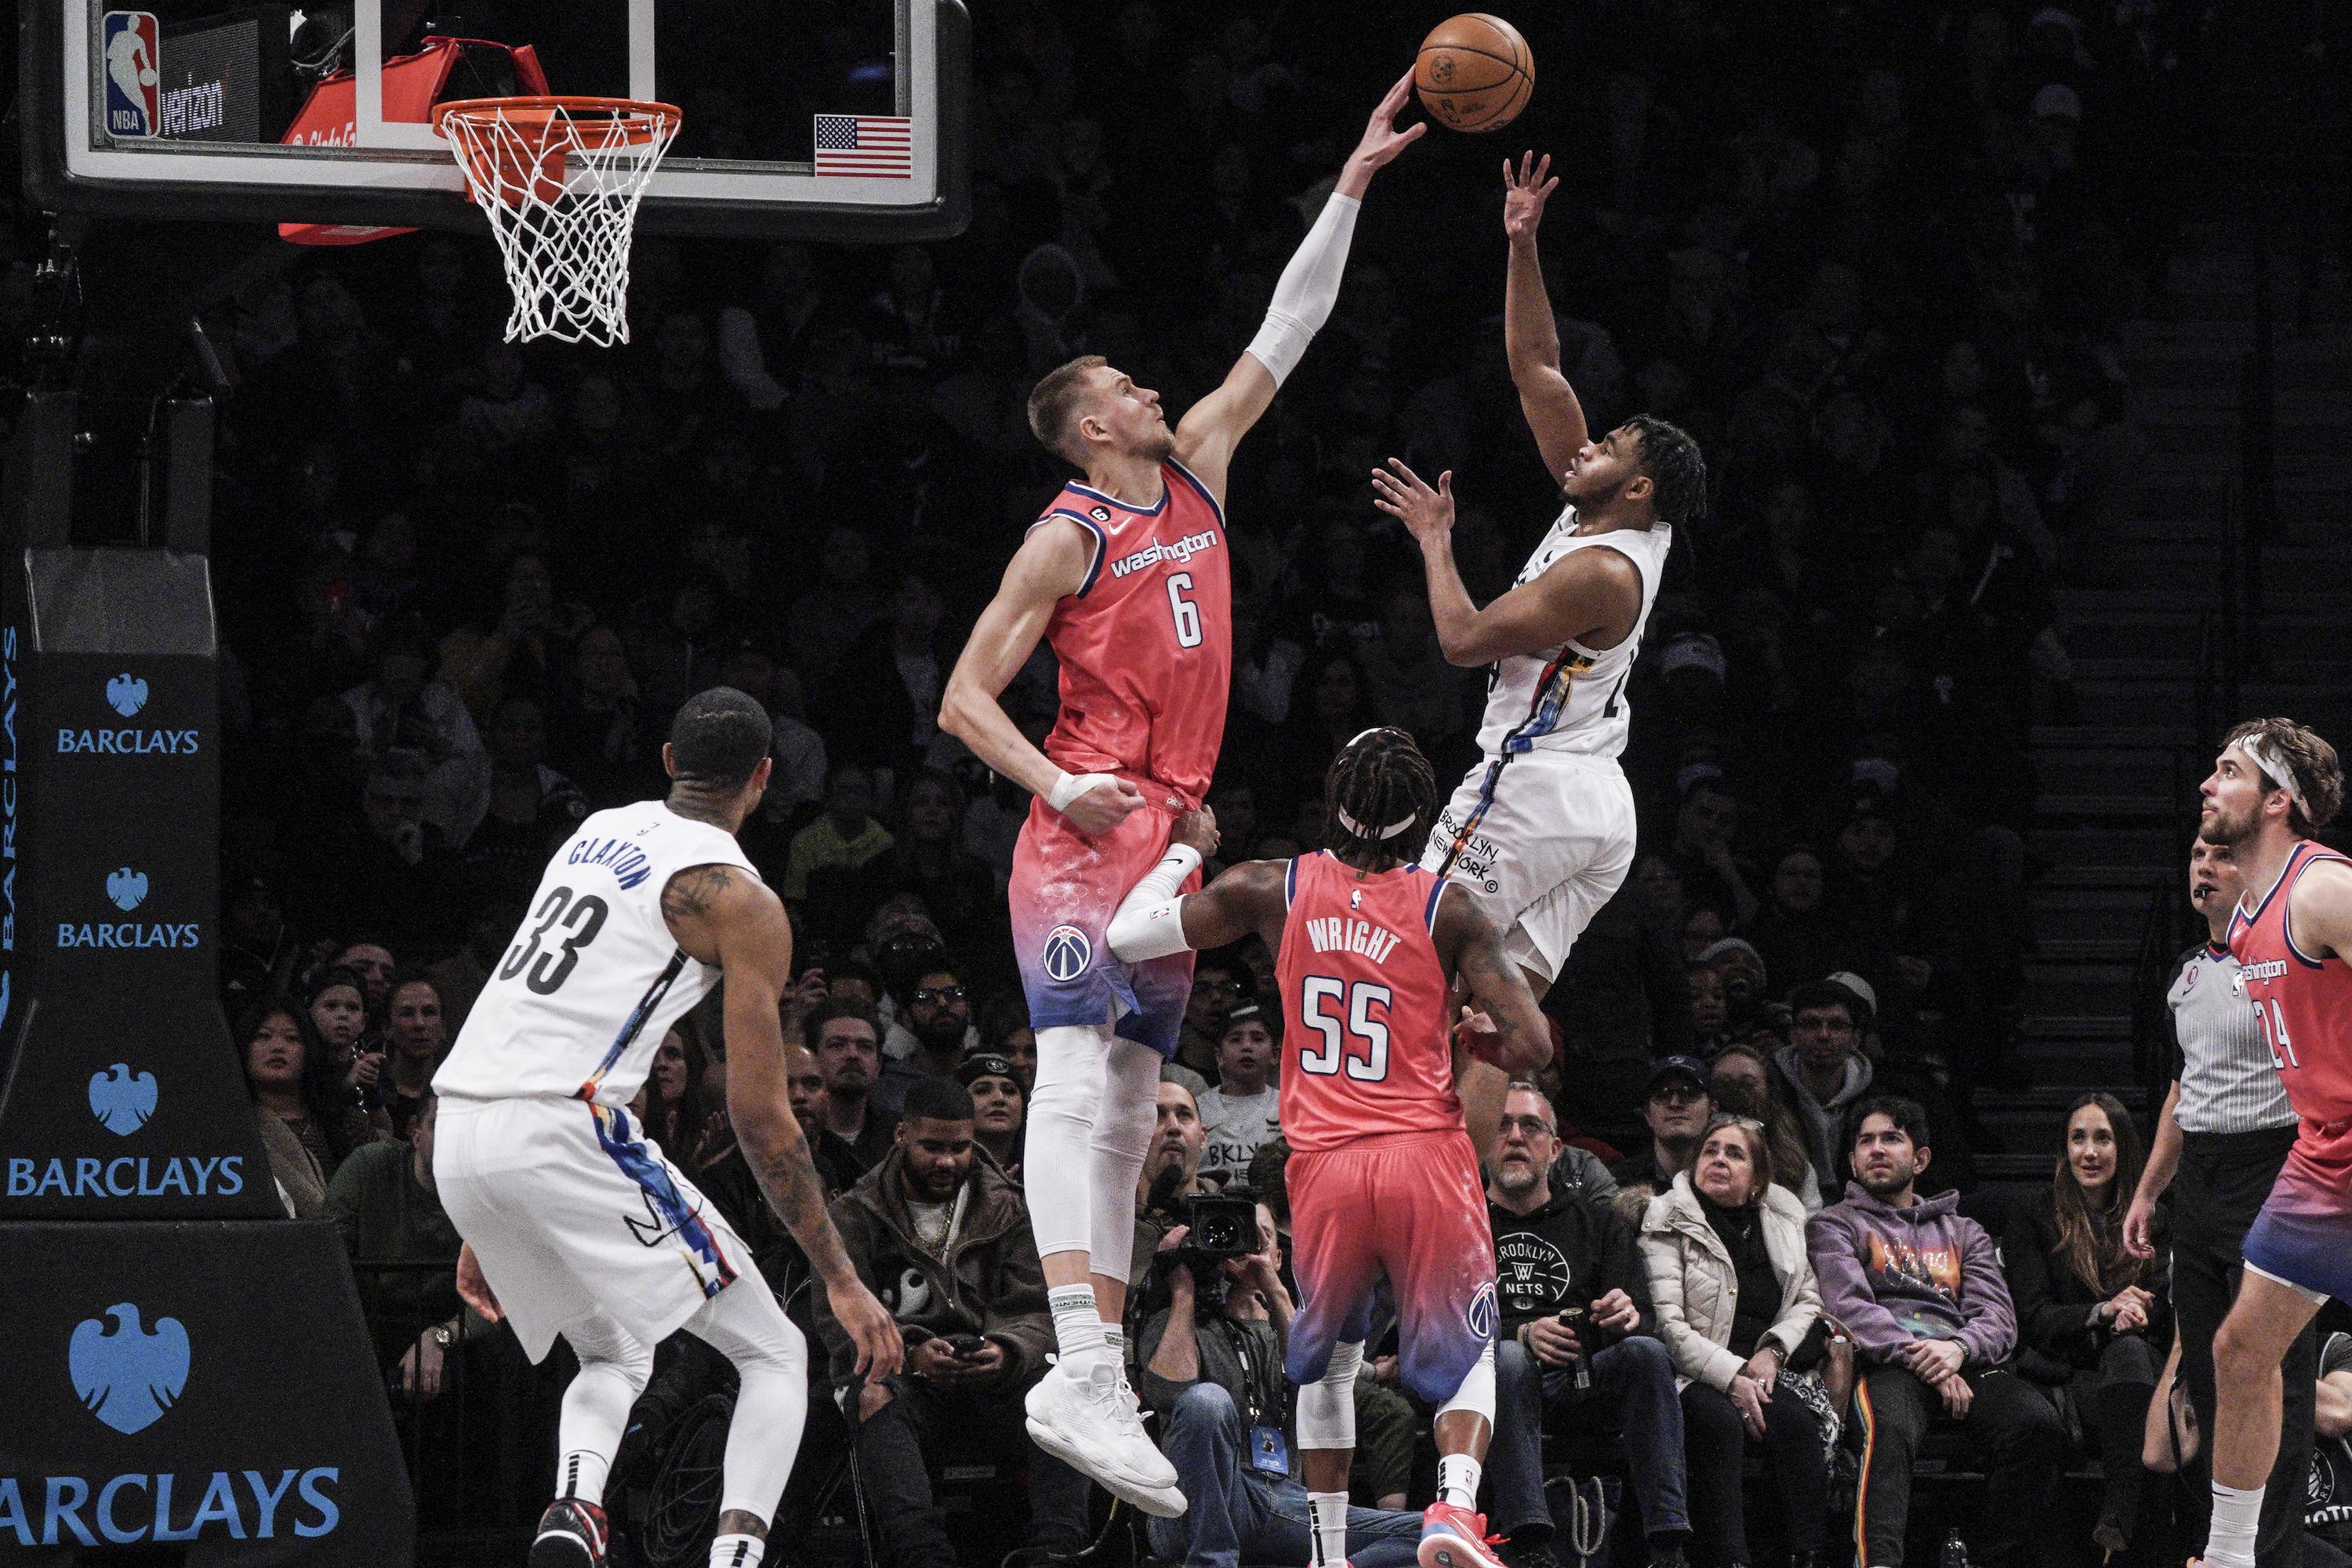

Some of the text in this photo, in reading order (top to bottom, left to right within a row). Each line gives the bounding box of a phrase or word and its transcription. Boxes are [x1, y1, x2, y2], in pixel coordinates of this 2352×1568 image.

[112, 110, 140, 130] NBA
[161, 72, 223, 135] verizon
[1091, 508, 1108, 521] 6
[1167, 572, 1202, 648] 6
[56, 729, 199, 754] BARCLAYS
[2, 626, 16, 951] BARCLAYS
[1430, 829, 1451, 857] NEW
[1454, 852, 1489, 881] YORK
[56, 923, 199, 948] BARCLAYS
[499, 886, 608, 996] 33
[1305, 916, 1402, 964] WRIGHT
[2242, 956, 2288, 985] ashington
[1299, 975, 1392, 1082] 55
[2252, 997, 2299, 1069] 24
[6, 1156, 244, 1197] BARCLAYS
[1505, 1283, 1544, 1296] NETS
